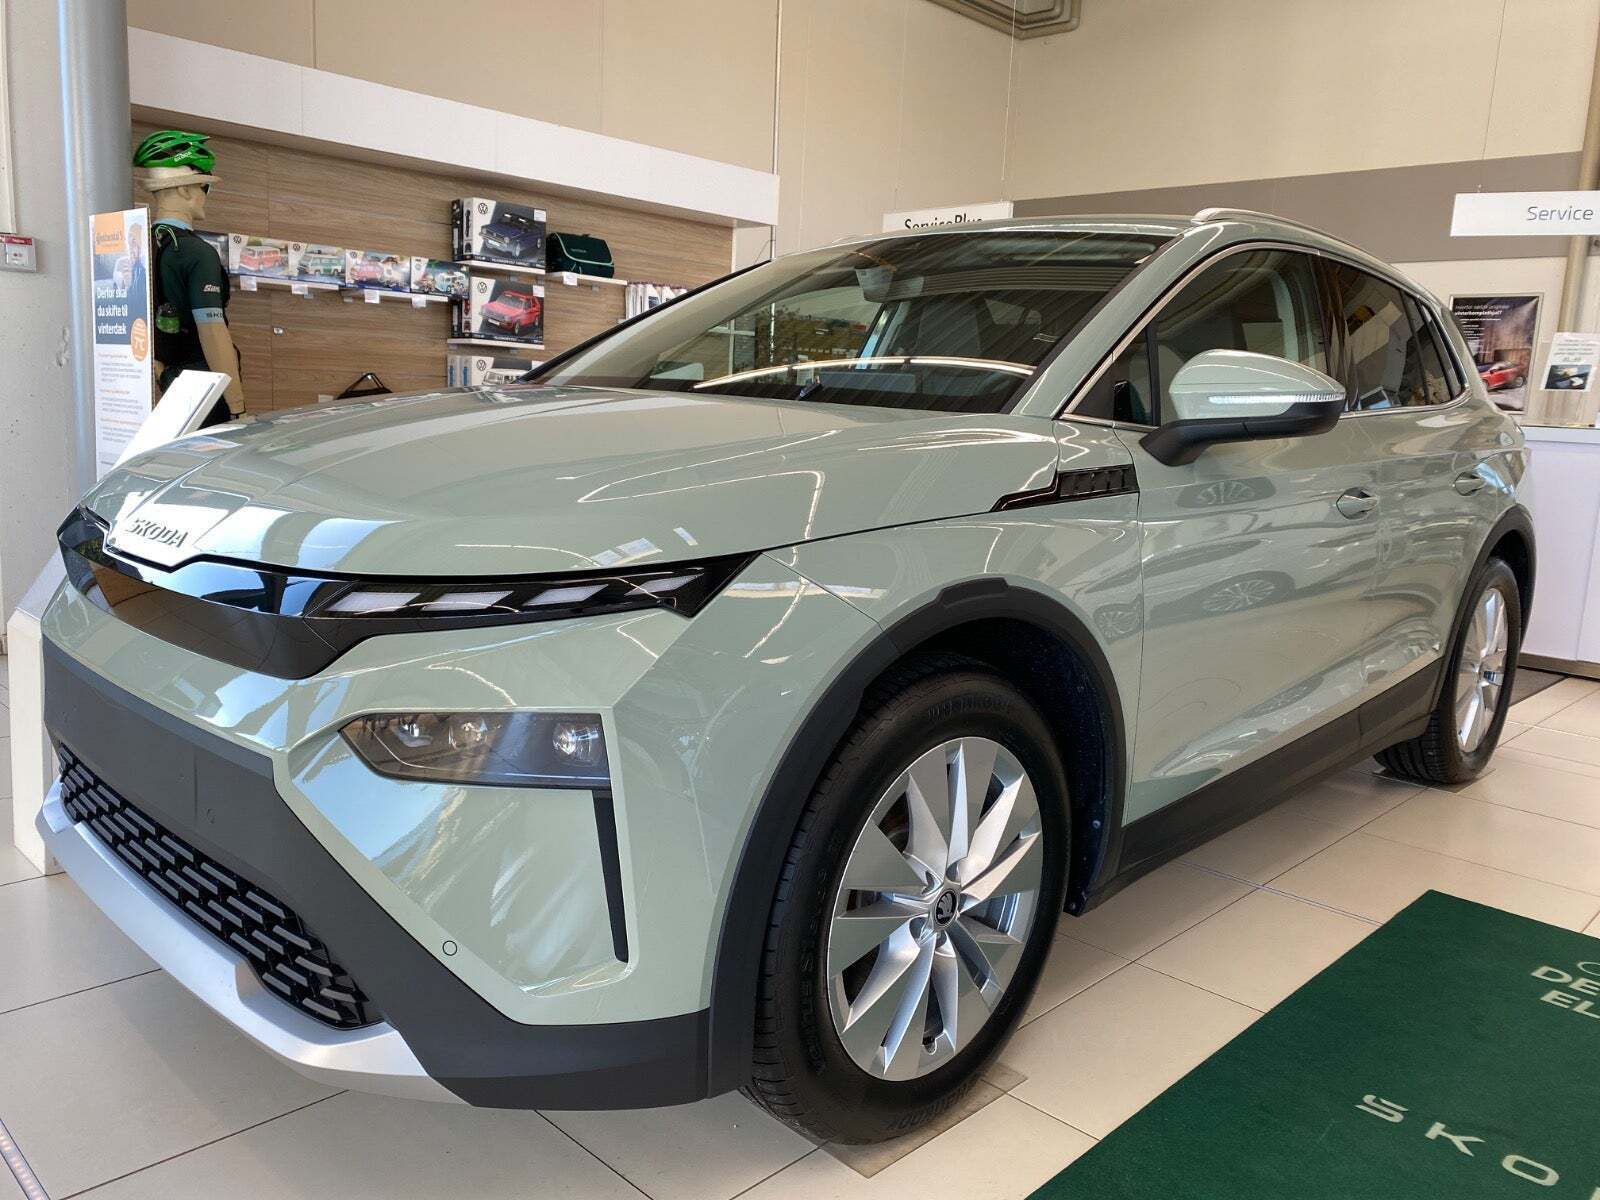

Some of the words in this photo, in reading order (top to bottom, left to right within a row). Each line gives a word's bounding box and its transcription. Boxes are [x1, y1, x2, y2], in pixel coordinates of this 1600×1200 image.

[1527, 205, 1594, 221] Service
[96, 287, 115, 299] Derfor
[97, 305, 105, 317] du
[105, 305, 121, 317] skifte
